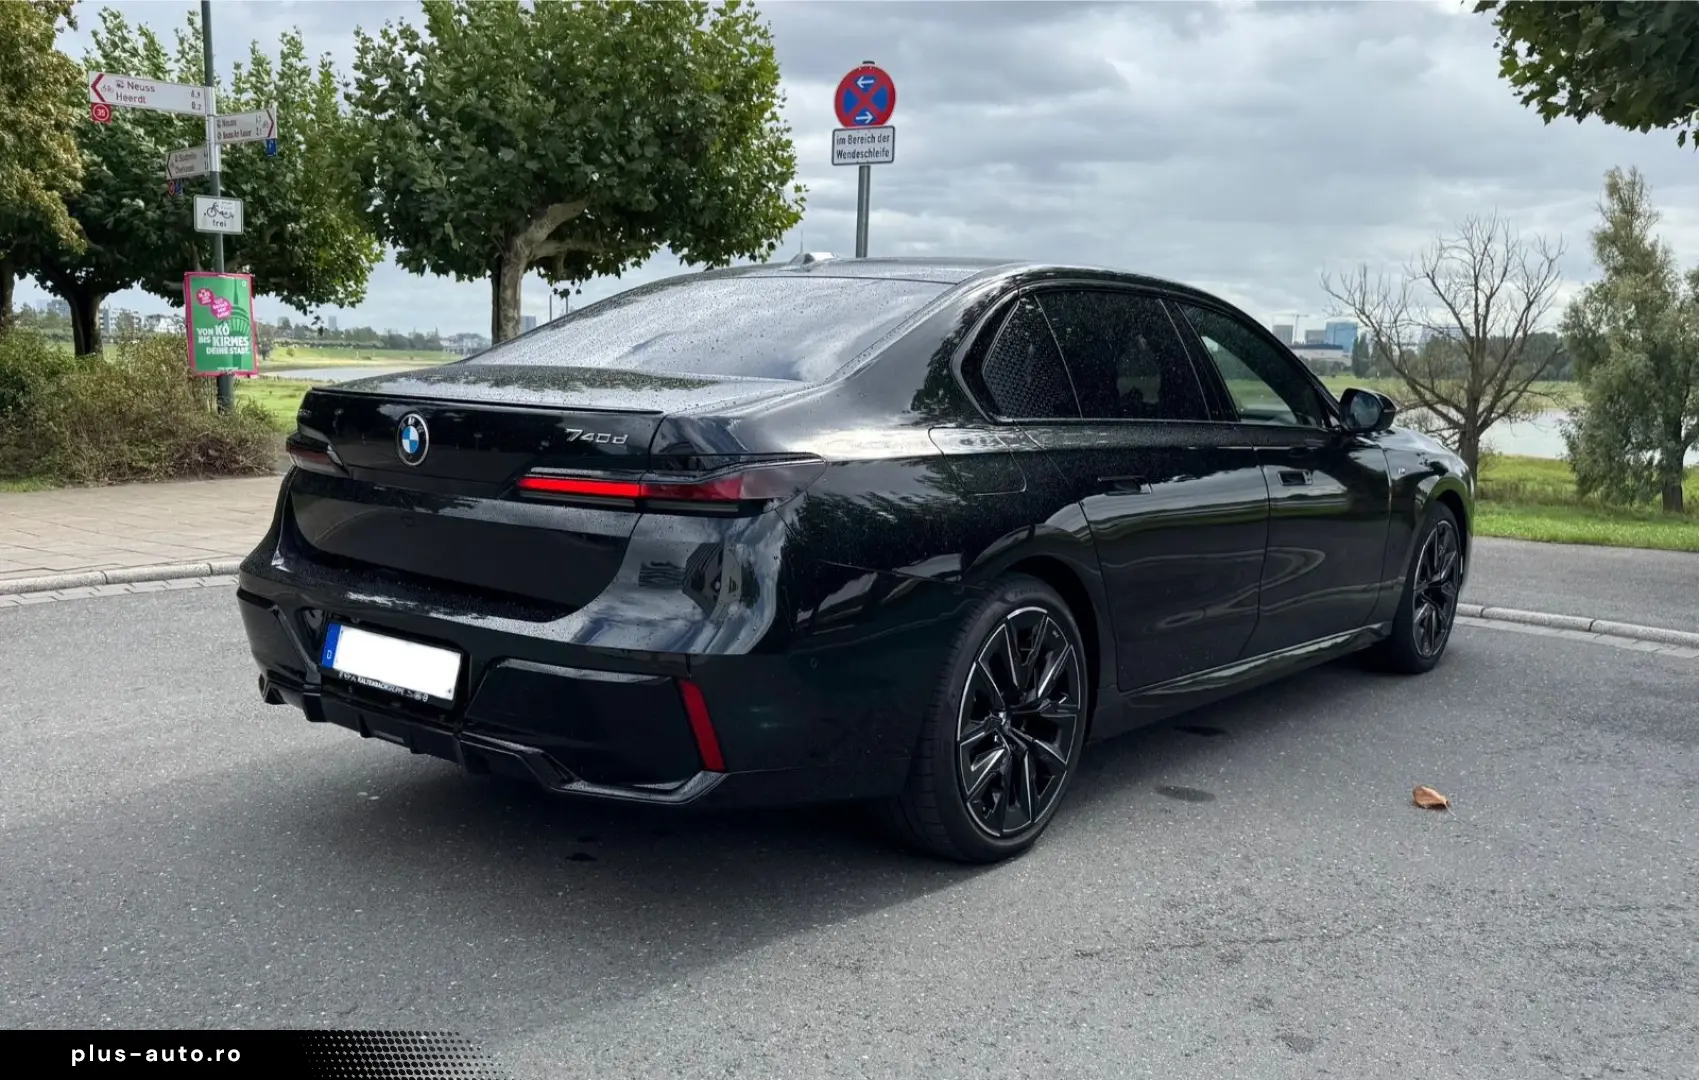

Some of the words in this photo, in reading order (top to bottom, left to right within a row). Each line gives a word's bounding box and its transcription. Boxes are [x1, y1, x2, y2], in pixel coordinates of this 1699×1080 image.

[127, 80, 156, 93] Neuss
[115, 91, 147, 104] Heerdt
[836, 135, 846, 145] im
[847, 133, 876, 145] Bereich
[877, 133, 890, 143] der
[836, 147, 890, 159] Wendeschleife
[212, 219, 227, 228] frei
[196, 327, 214, 336] VON
[214, 322, 230, 336] KÖ
[198, 335, 211, 344] BIS
[211, 335, 249, 347] KIRMES
[206, 346, 228, 355] DEINE
[565, 428, 628, 445] 740d
